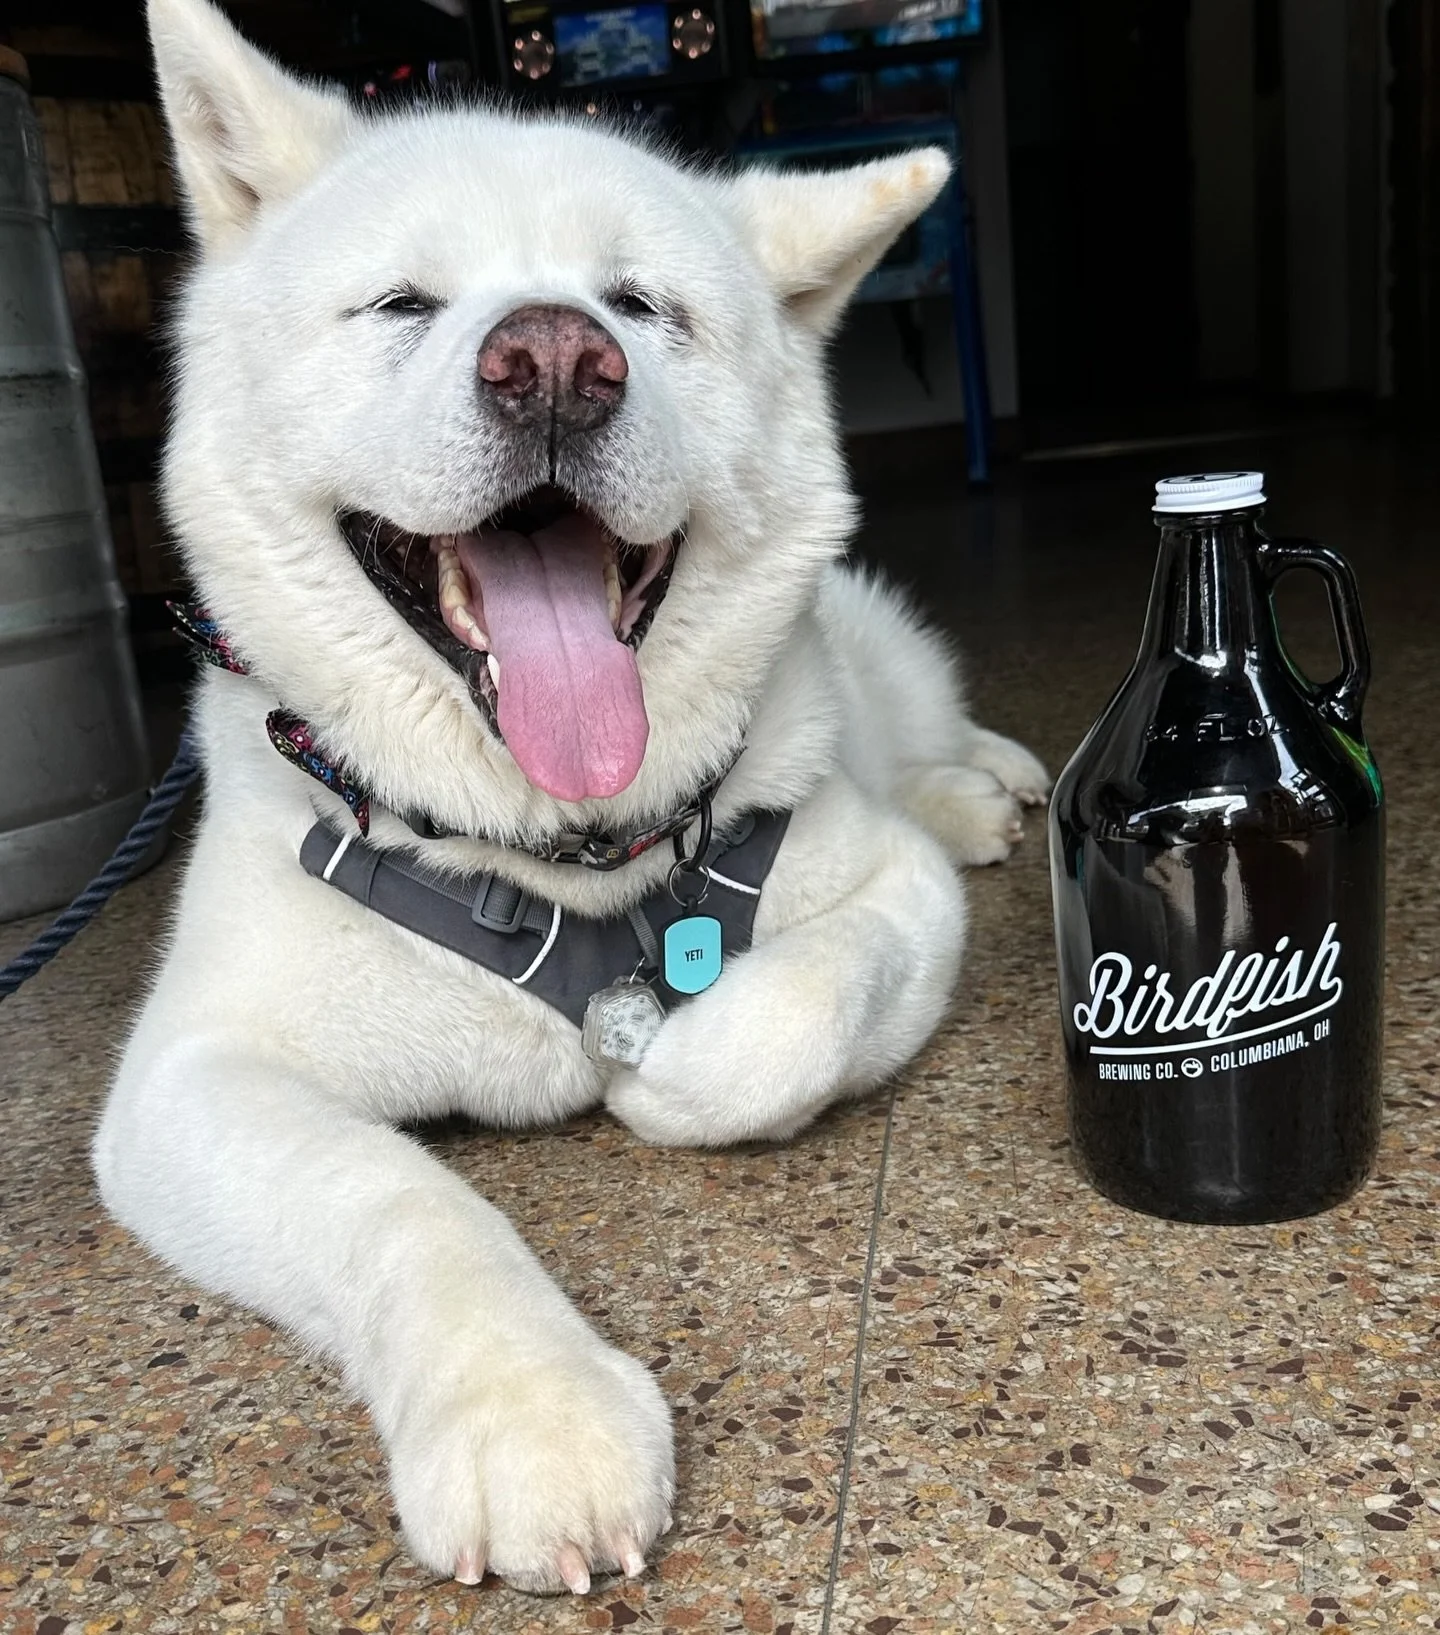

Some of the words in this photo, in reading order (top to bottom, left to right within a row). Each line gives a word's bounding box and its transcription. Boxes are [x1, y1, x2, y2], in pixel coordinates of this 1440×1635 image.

[685, 948, 703, 962] YETI
[1073, 922, 1343, 1039] Birdfish
[1099, 1063, 1151, 1080] BREWING
[1156, 1062, 1179, 1079] CO.
[1314, 1019, 1330, 1041] OH
